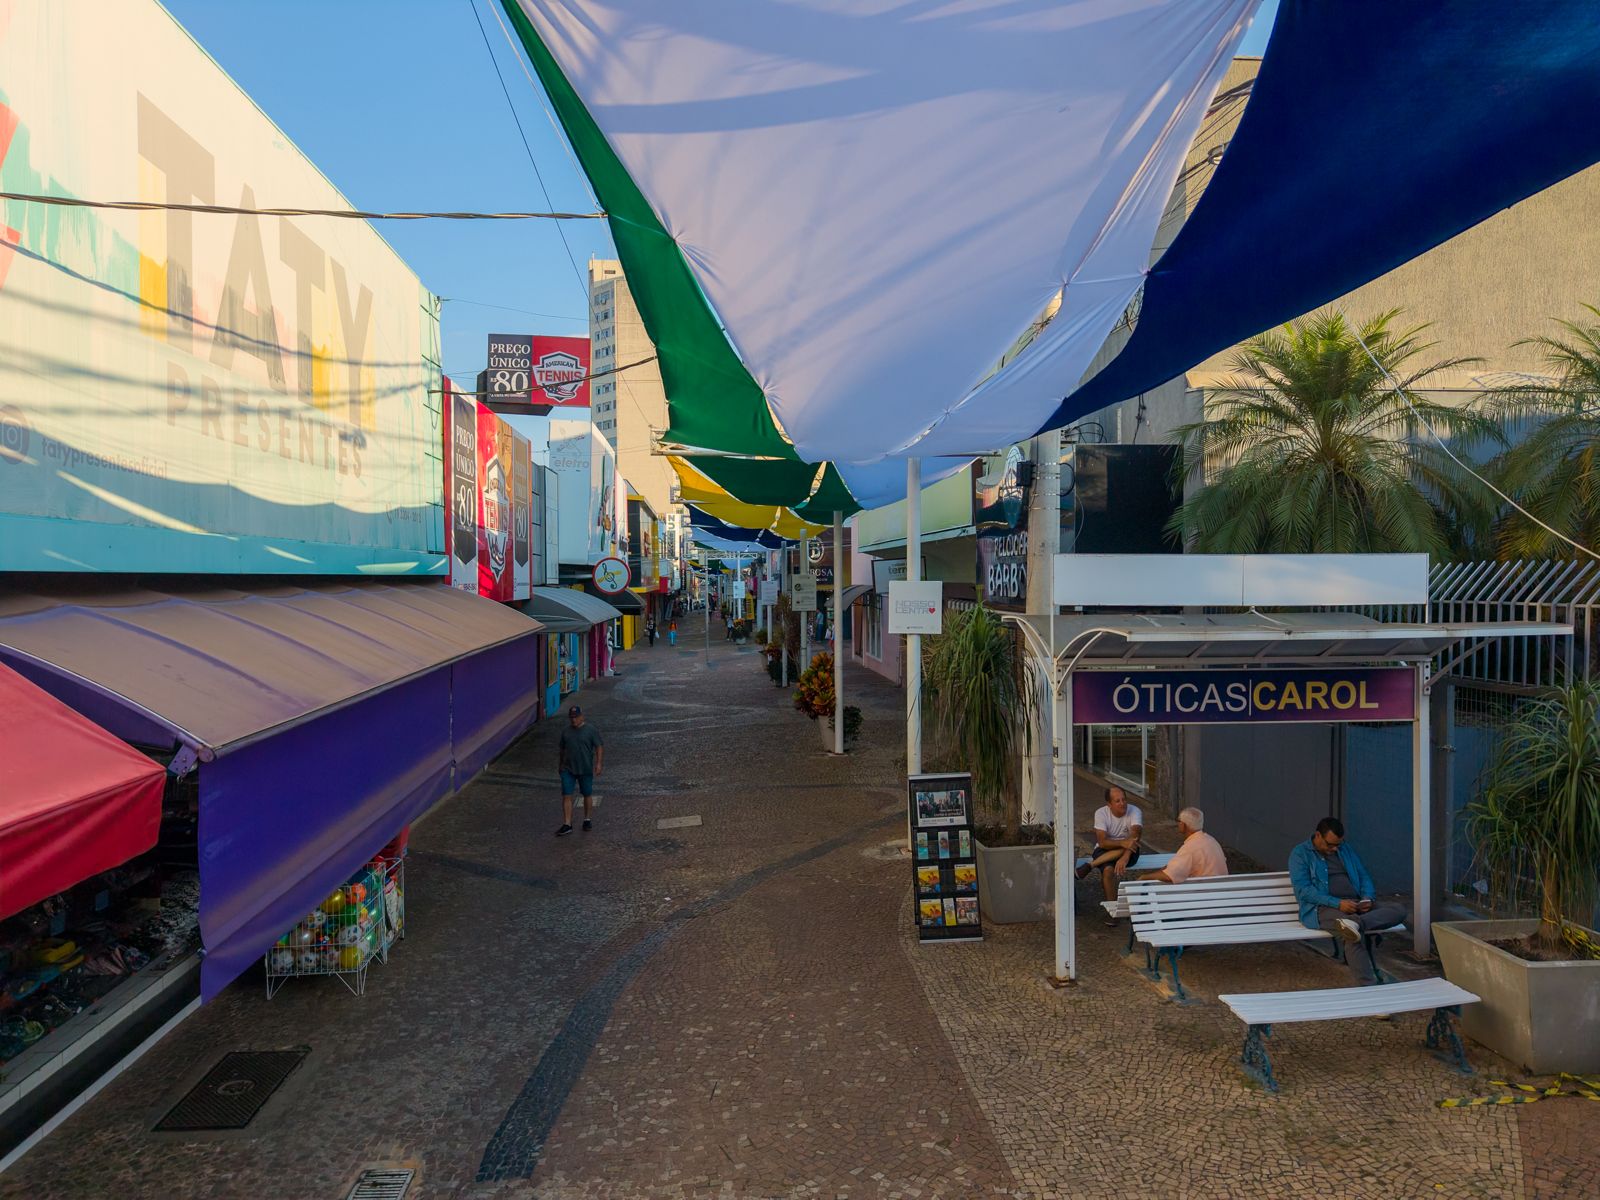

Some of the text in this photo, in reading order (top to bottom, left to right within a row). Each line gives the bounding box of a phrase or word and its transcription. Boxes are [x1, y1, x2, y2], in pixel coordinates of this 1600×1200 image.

[137, 90, 374, 427] TATY
[491, 343, 530, 356] PREÇO
[490, 354, 530, 369] ÚNICO
[537, 370, 582, 383] TENNIS
[167, 360, 362, 478] PRESENTES
[554, 457, 590, 468] eletro
[1112, 677, 1379, 713] ÓTICAS CAROL
